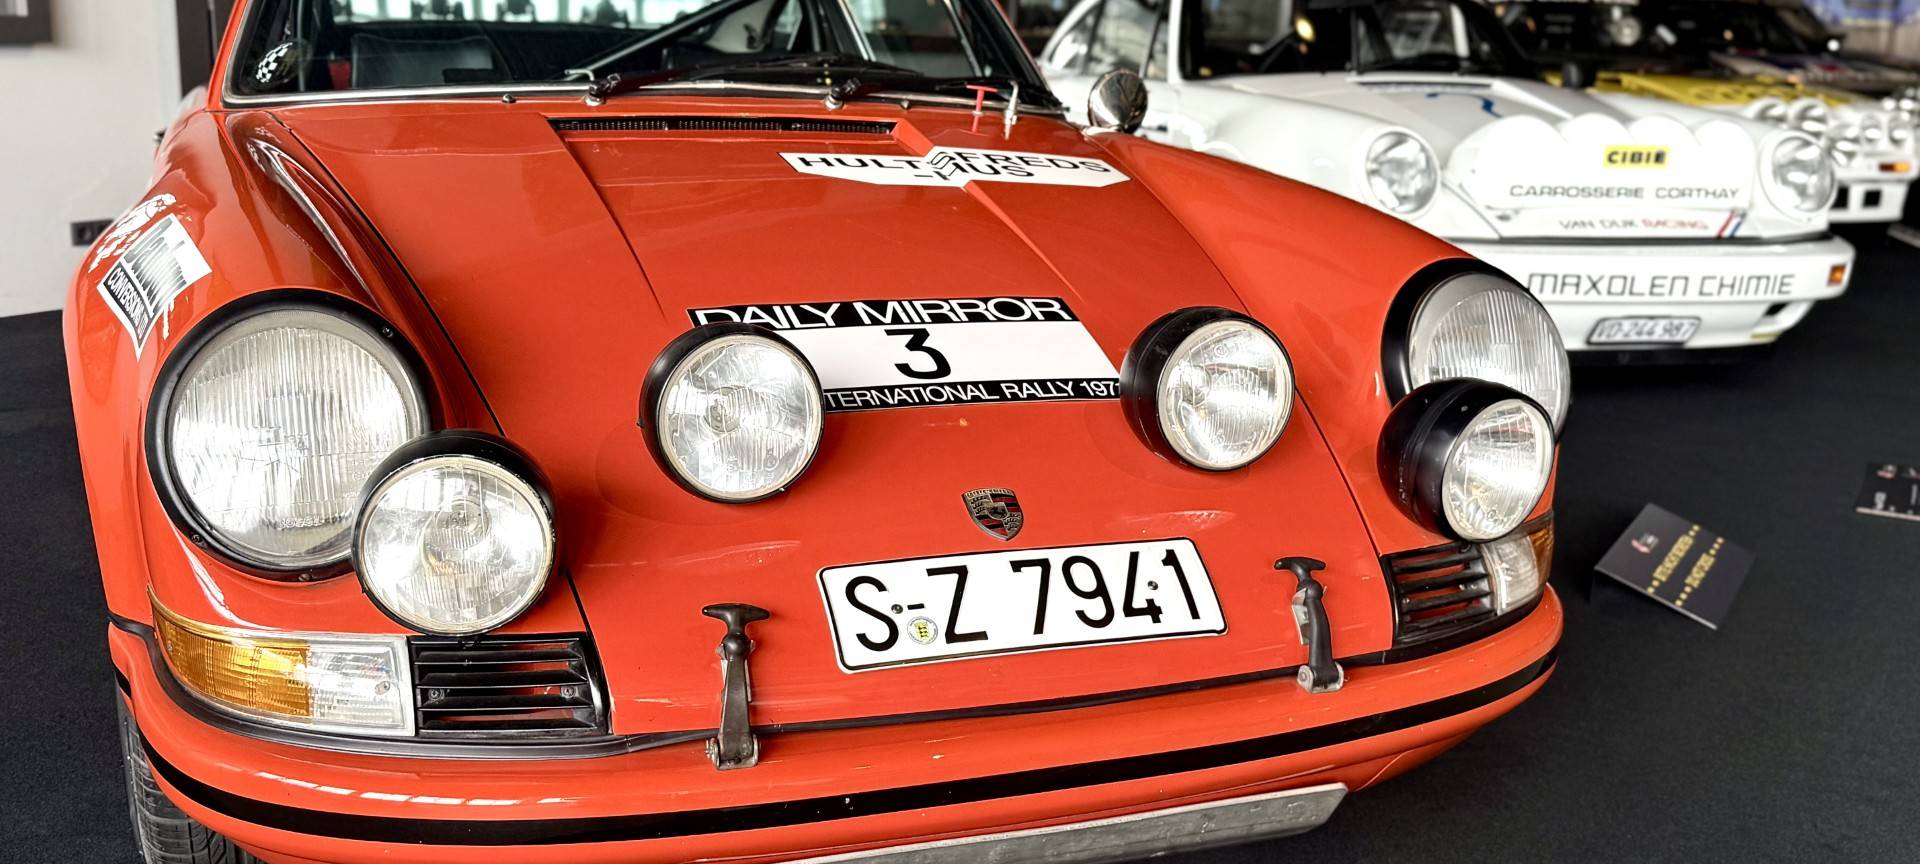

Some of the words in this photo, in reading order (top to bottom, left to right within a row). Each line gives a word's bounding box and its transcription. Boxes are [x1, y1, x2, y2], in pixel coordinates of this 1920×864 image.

[1509, 185, 1644, 199] CARROSSERIE
[1655, 187, 1739, 199] CORTHAY
[1558, 218, 1596, 230] VAN
[1527, 273, 1690, 297] MAXOLEN
[1698, 274, 1796, 297] CHIMIE
[694, 303, 842, 330] DAILY
[852, 298, 1073, 327] MIRROR
[884, 328, 952, 380] 3
[824, 383, 999, 408] TERNATIONAL
[1000, 381, 1075, 400] RALLY
[1009, 549, 1201, 635] 7941
